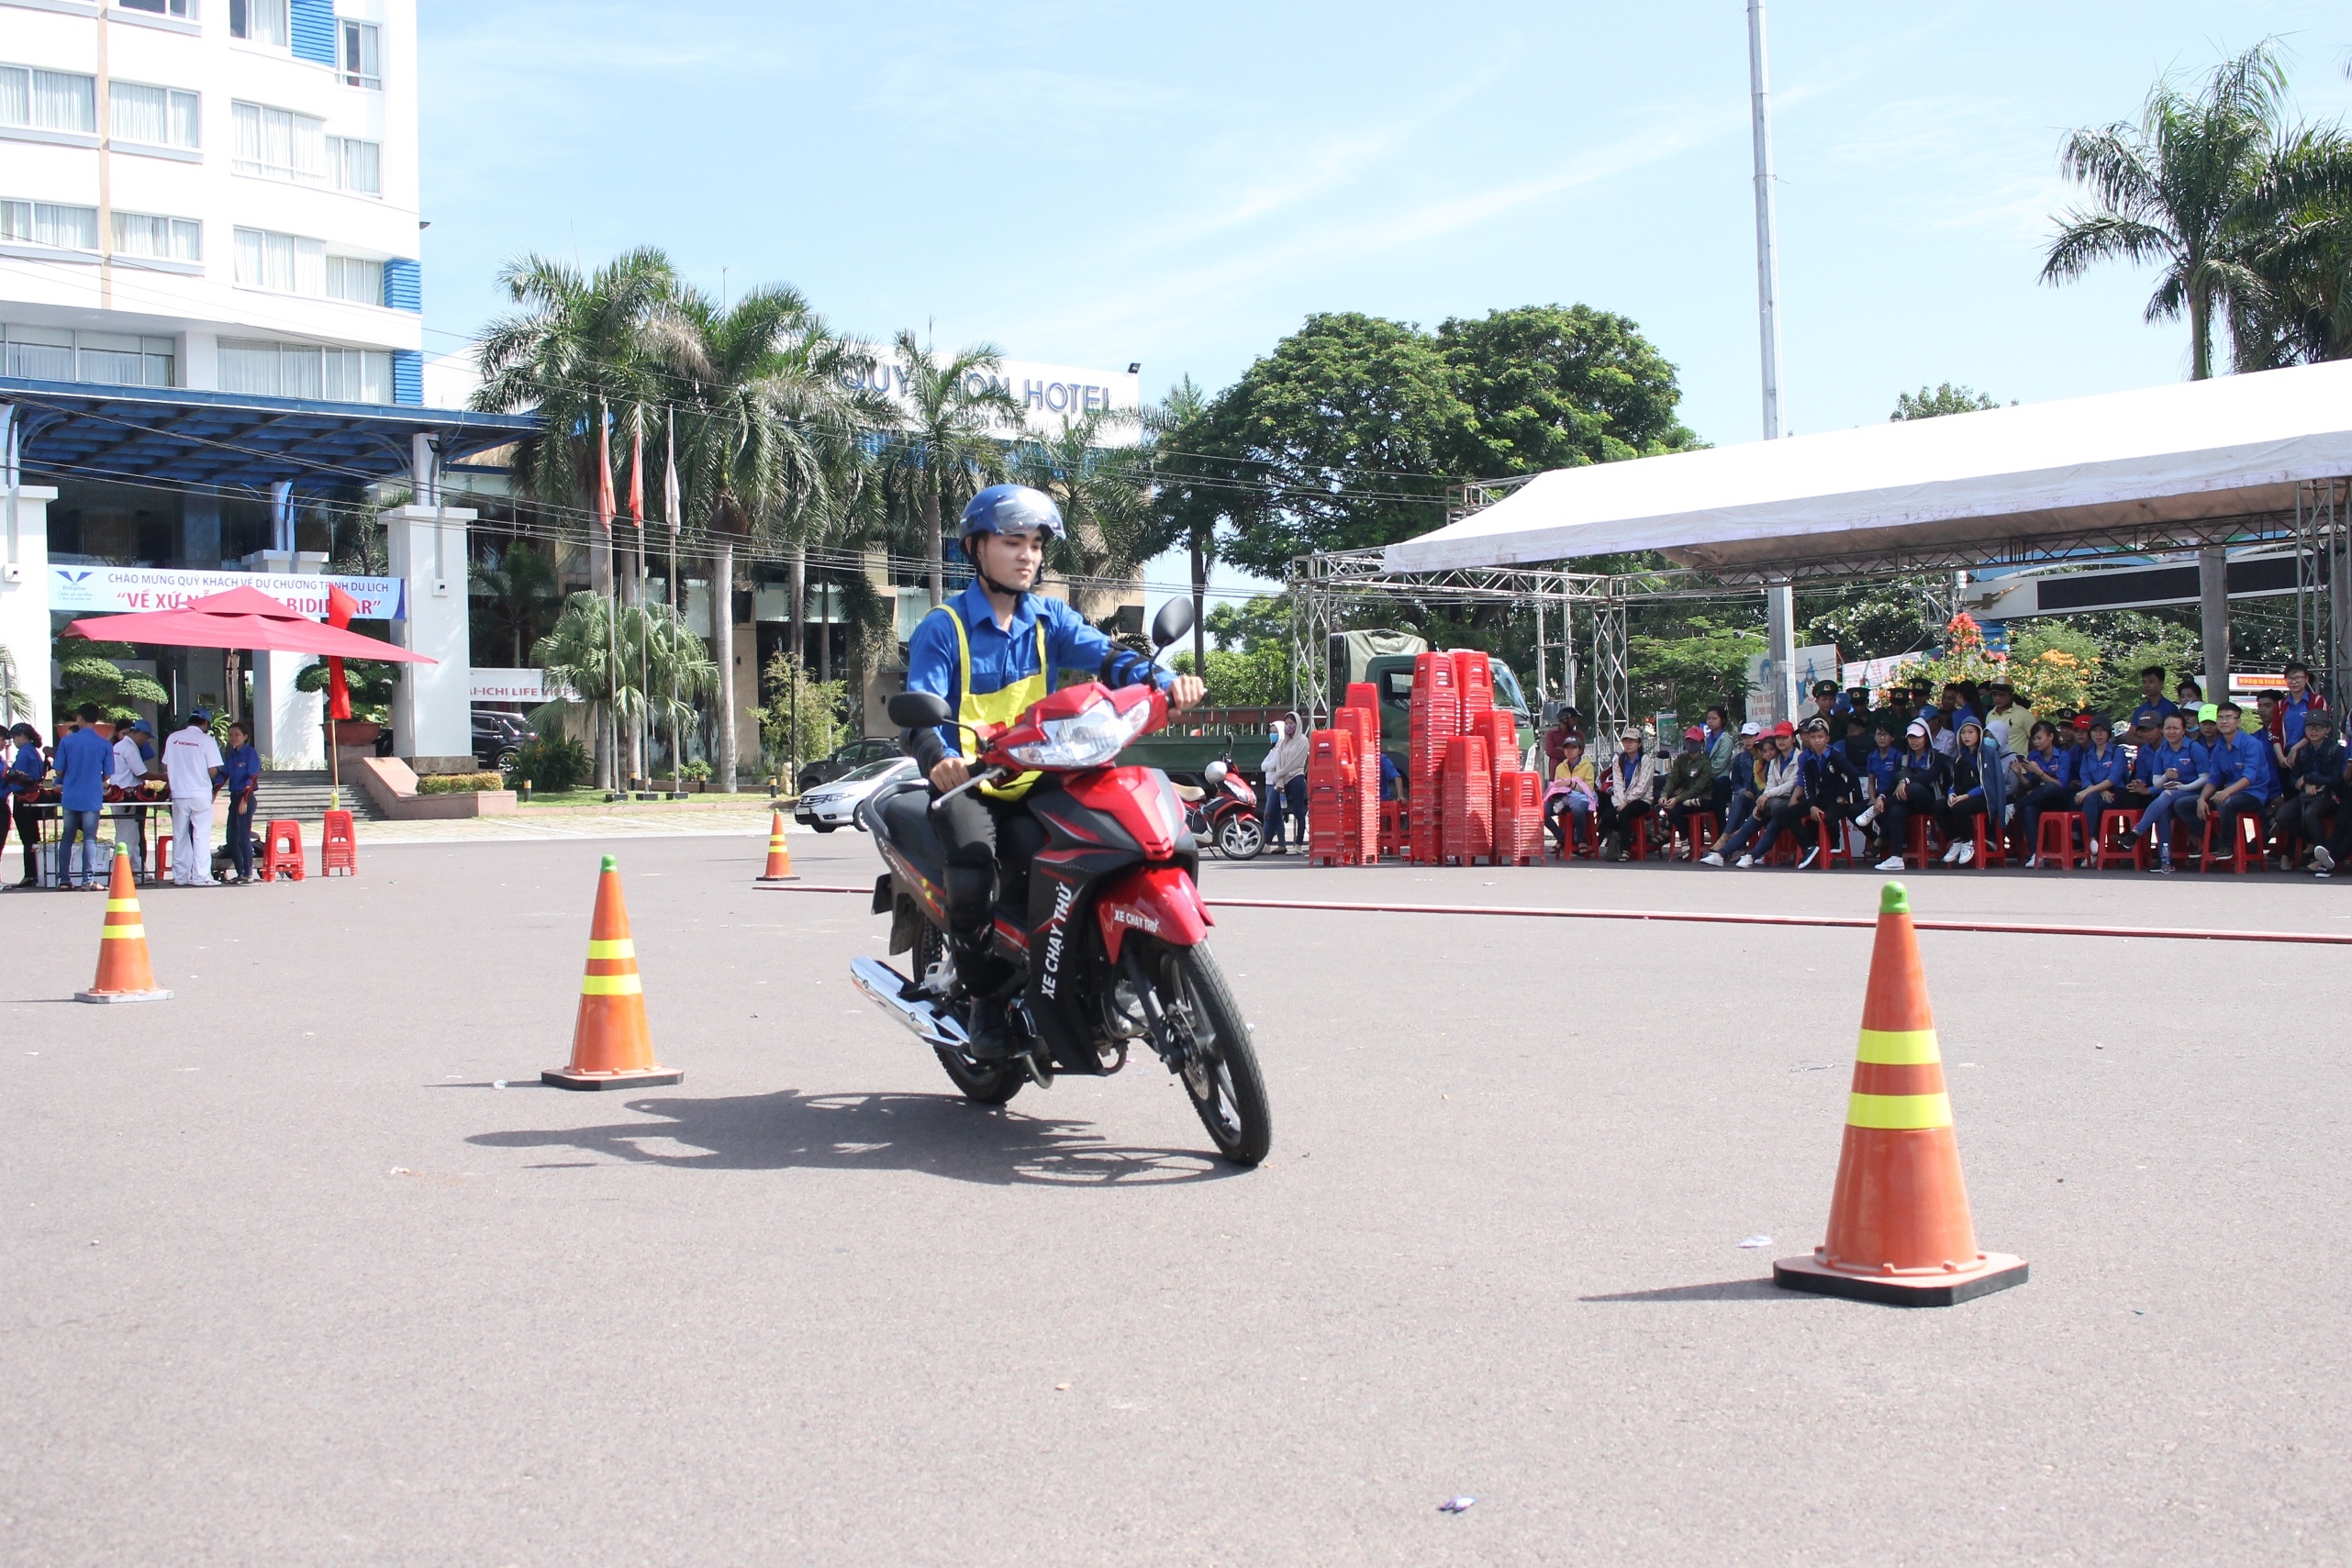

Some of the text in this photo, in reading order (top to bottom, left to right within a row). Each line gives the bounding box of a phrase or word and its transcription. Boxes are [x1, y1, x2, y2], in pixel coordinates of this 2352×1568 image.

[1023, 379, 1117, 415] HOTEL
[108, 572, 139, 584] CHÀO
[141, 573, 175, 585] MỪNG
[177, 574, 200, 586] QUÝ
[203, 575, 239, 588] KHÁCH
[256, 577, 272, 591] DỰ
[273, 578, 318, 590] CHƯƠNG
[351, 582, 365, 592] DU
[367, 583, 389, 595] LỊCH
[155, 590, 182, 609] XỨ
[511, 687, 539, 696] LIFE
[1113, 909, 1160, 933] XE CHẠY THỬ
[1041, 882, 1073, 1000] XE CHẠY THỬ
